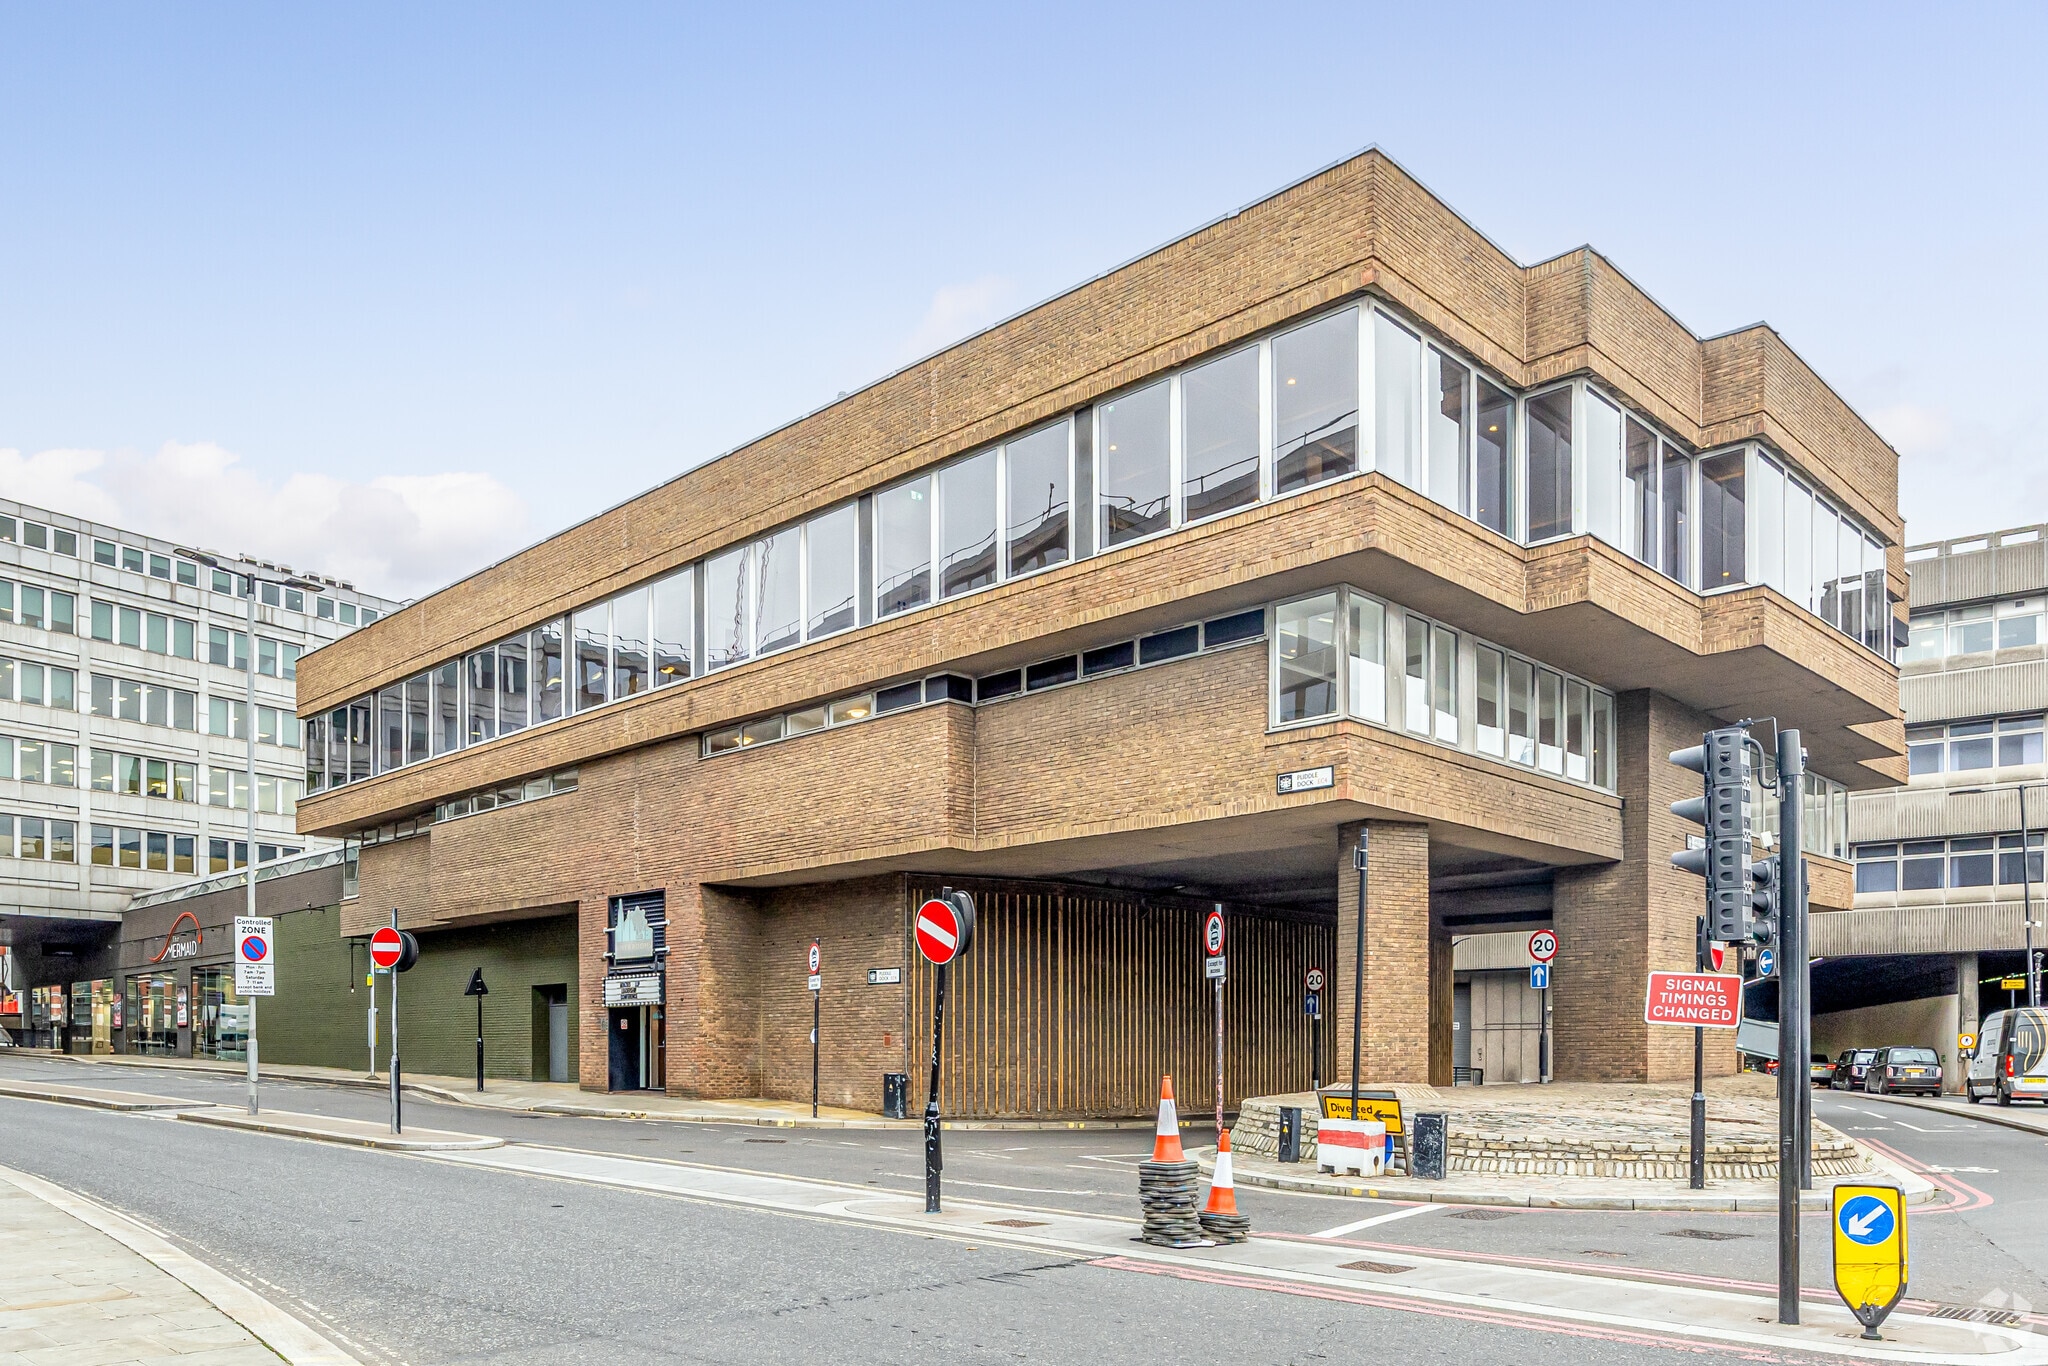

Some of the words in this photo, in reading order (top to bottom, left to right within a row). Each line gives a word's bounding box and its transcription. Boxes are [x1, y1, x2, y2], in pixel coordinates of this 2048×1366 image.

[1297, 772, 1318, 780] PUDDLE
[236, 918, 272, 926] Controlled
[241, 926, 266, 934] ZONE
[161, 941, 197, 960] MERMAID
[1534, 939, 1554, 952] 20
[1308, 974, 1323, 985] 20
[1665, 979, 1724, 992] SIGNAL
[1660, 992, 1727, 1007] TIMINGS
[1653, 1005, 1732, 1021] CHANGED
